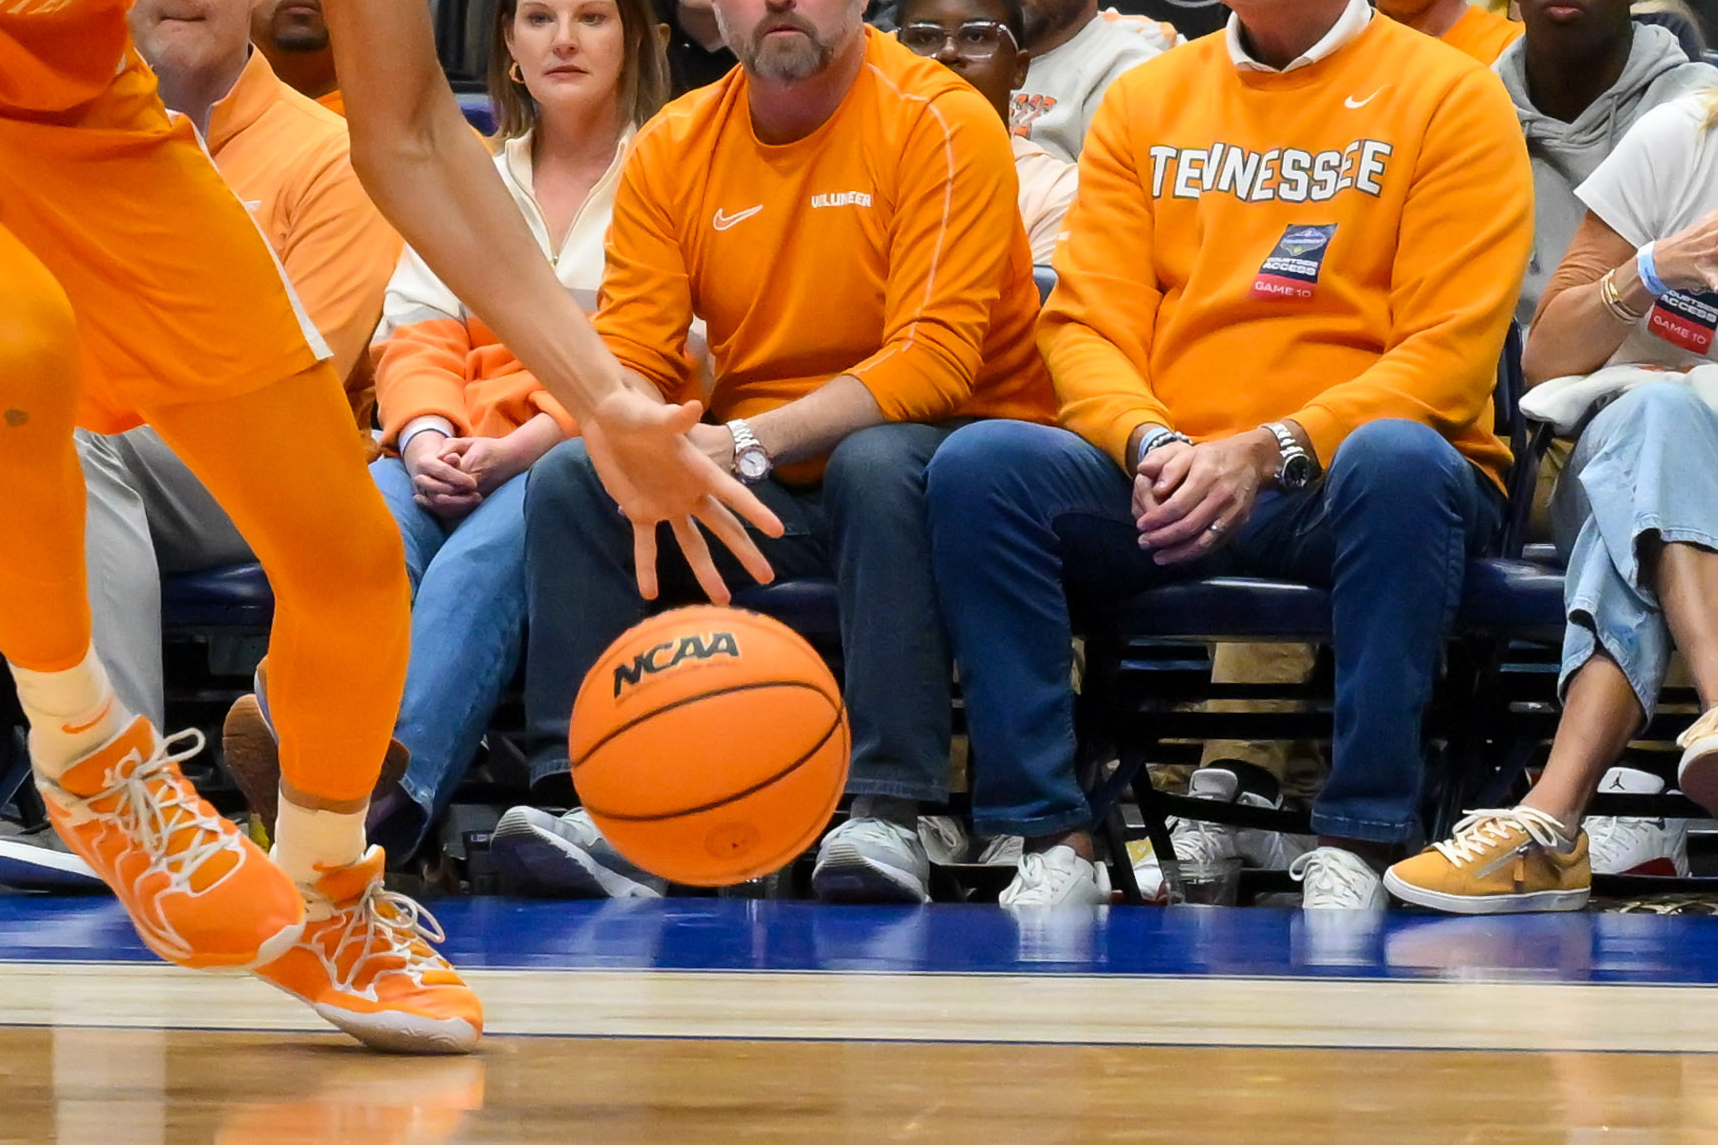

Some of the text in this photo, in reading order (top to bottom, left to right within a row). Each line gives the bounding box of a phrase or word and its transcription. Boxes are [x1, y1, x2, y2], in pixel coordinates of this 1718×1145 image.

[1149, 139, 1394, 203] TENNESSEE
[1262, 262, 1316, 276] ACCESS
[1255, 280, 1312, 298] GAME 10
[1661, 294, 1717, 323] ACCESS
[1653, 315, 1707, 345] GAME 10
[613, 632, 740, 699] NCAA
